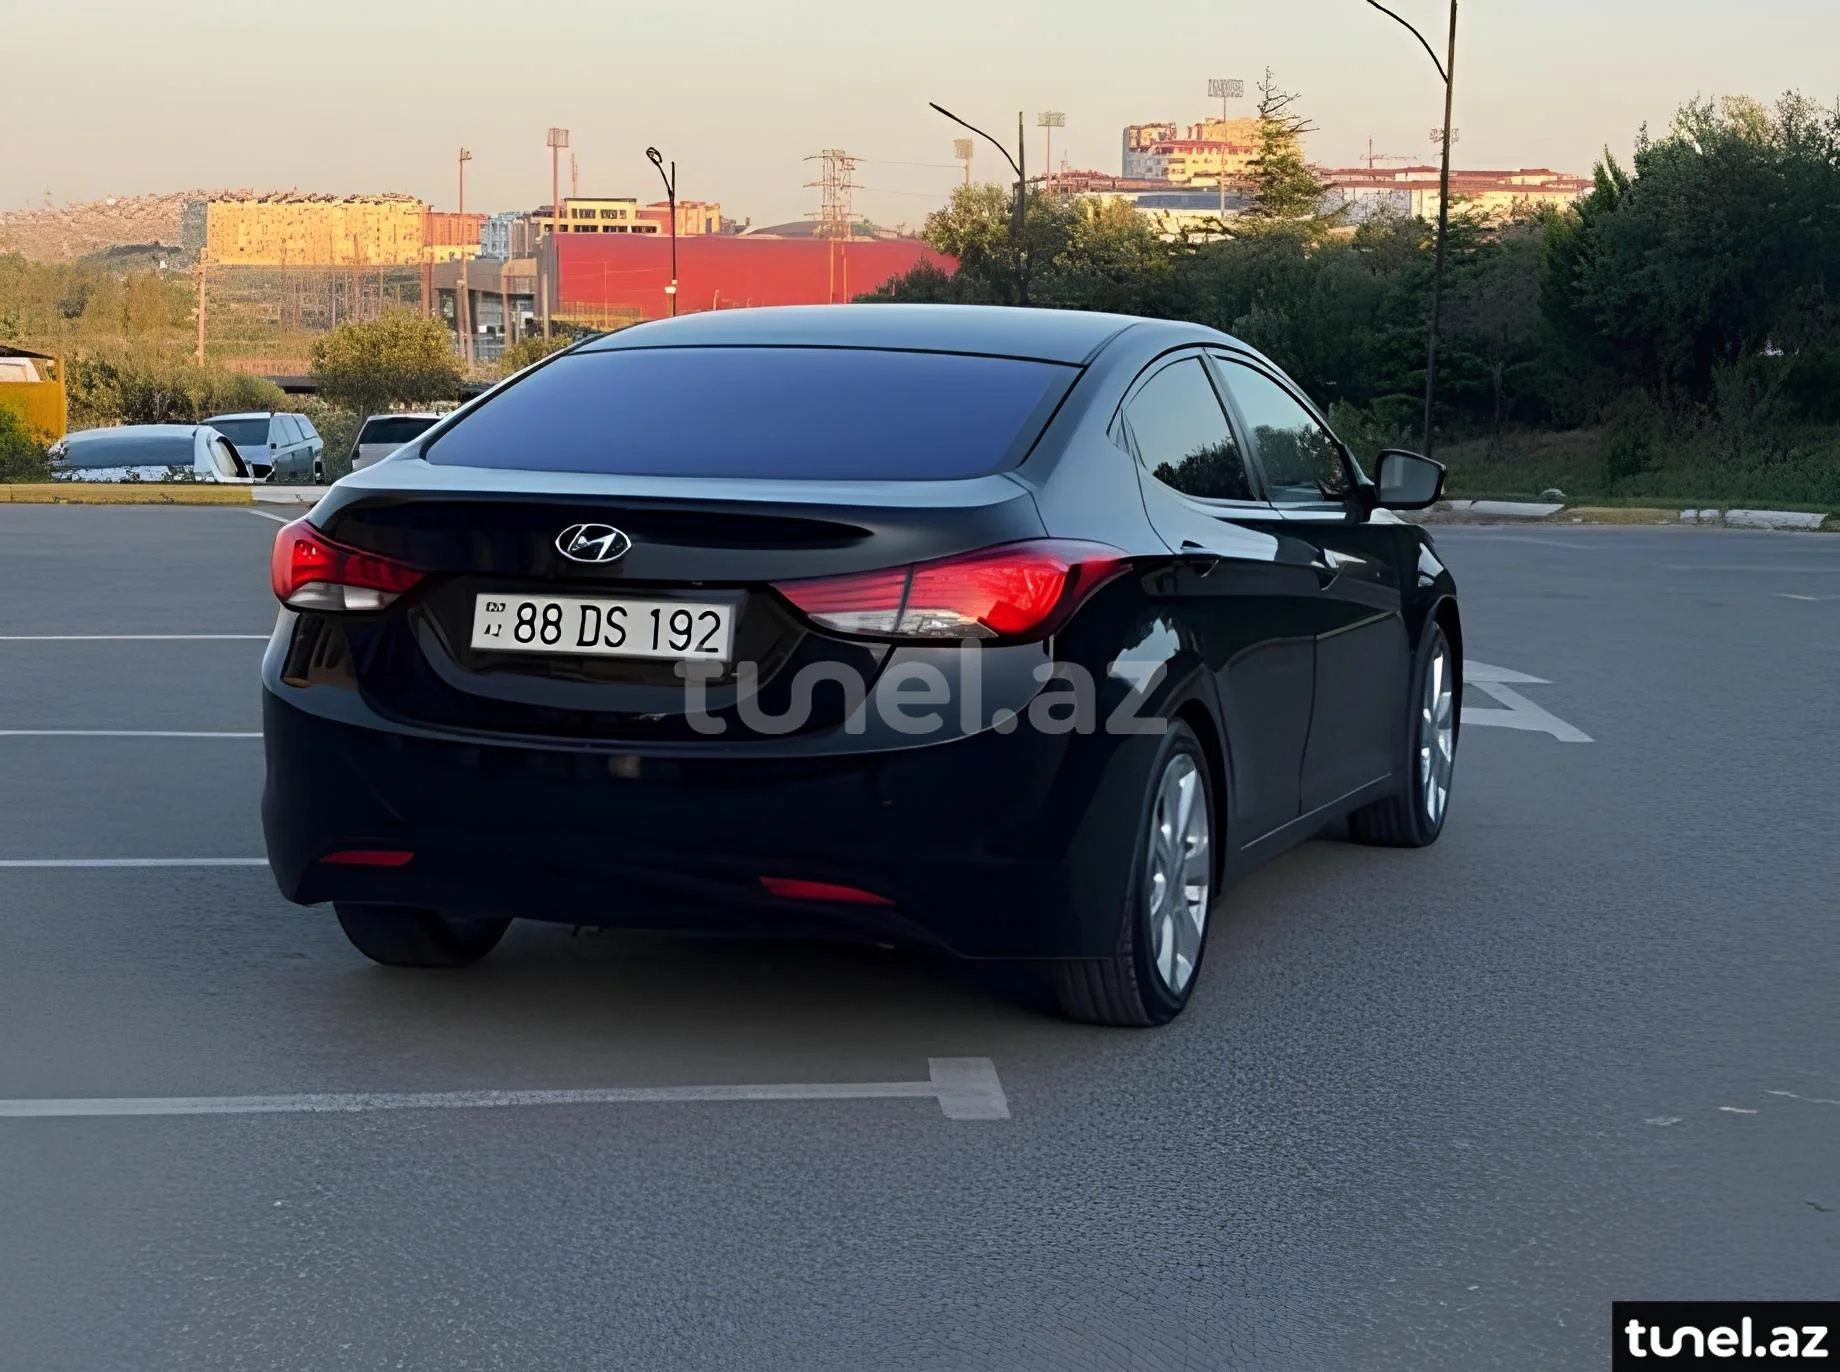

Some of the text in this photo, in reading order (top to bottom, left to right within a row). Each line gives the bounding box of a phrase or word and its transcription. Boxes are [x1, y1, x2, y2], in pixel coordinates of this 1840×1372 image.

[513, 602, 721, 653] 88 DS 192
